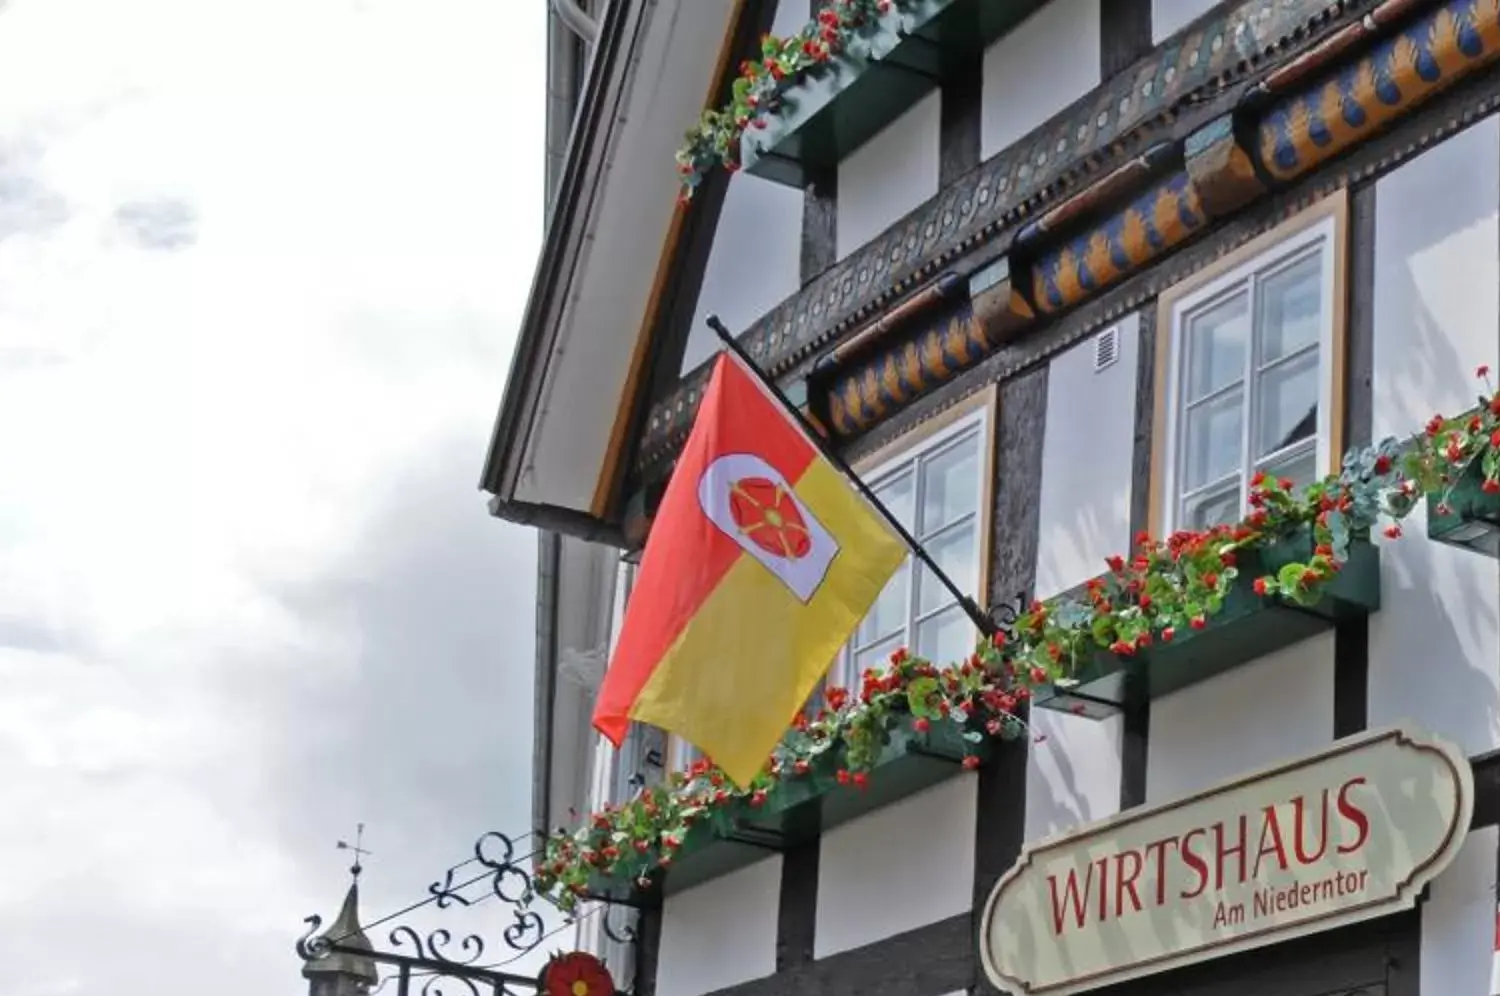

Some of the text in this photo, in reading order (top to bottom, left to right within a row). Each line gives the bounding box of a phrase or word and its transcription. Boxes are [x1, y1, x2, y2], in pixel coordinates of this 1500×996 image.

[1046, 776, 1370, 937] WIRTSHAUS
[1213, 868, 1369, 931] Am Niederntor
